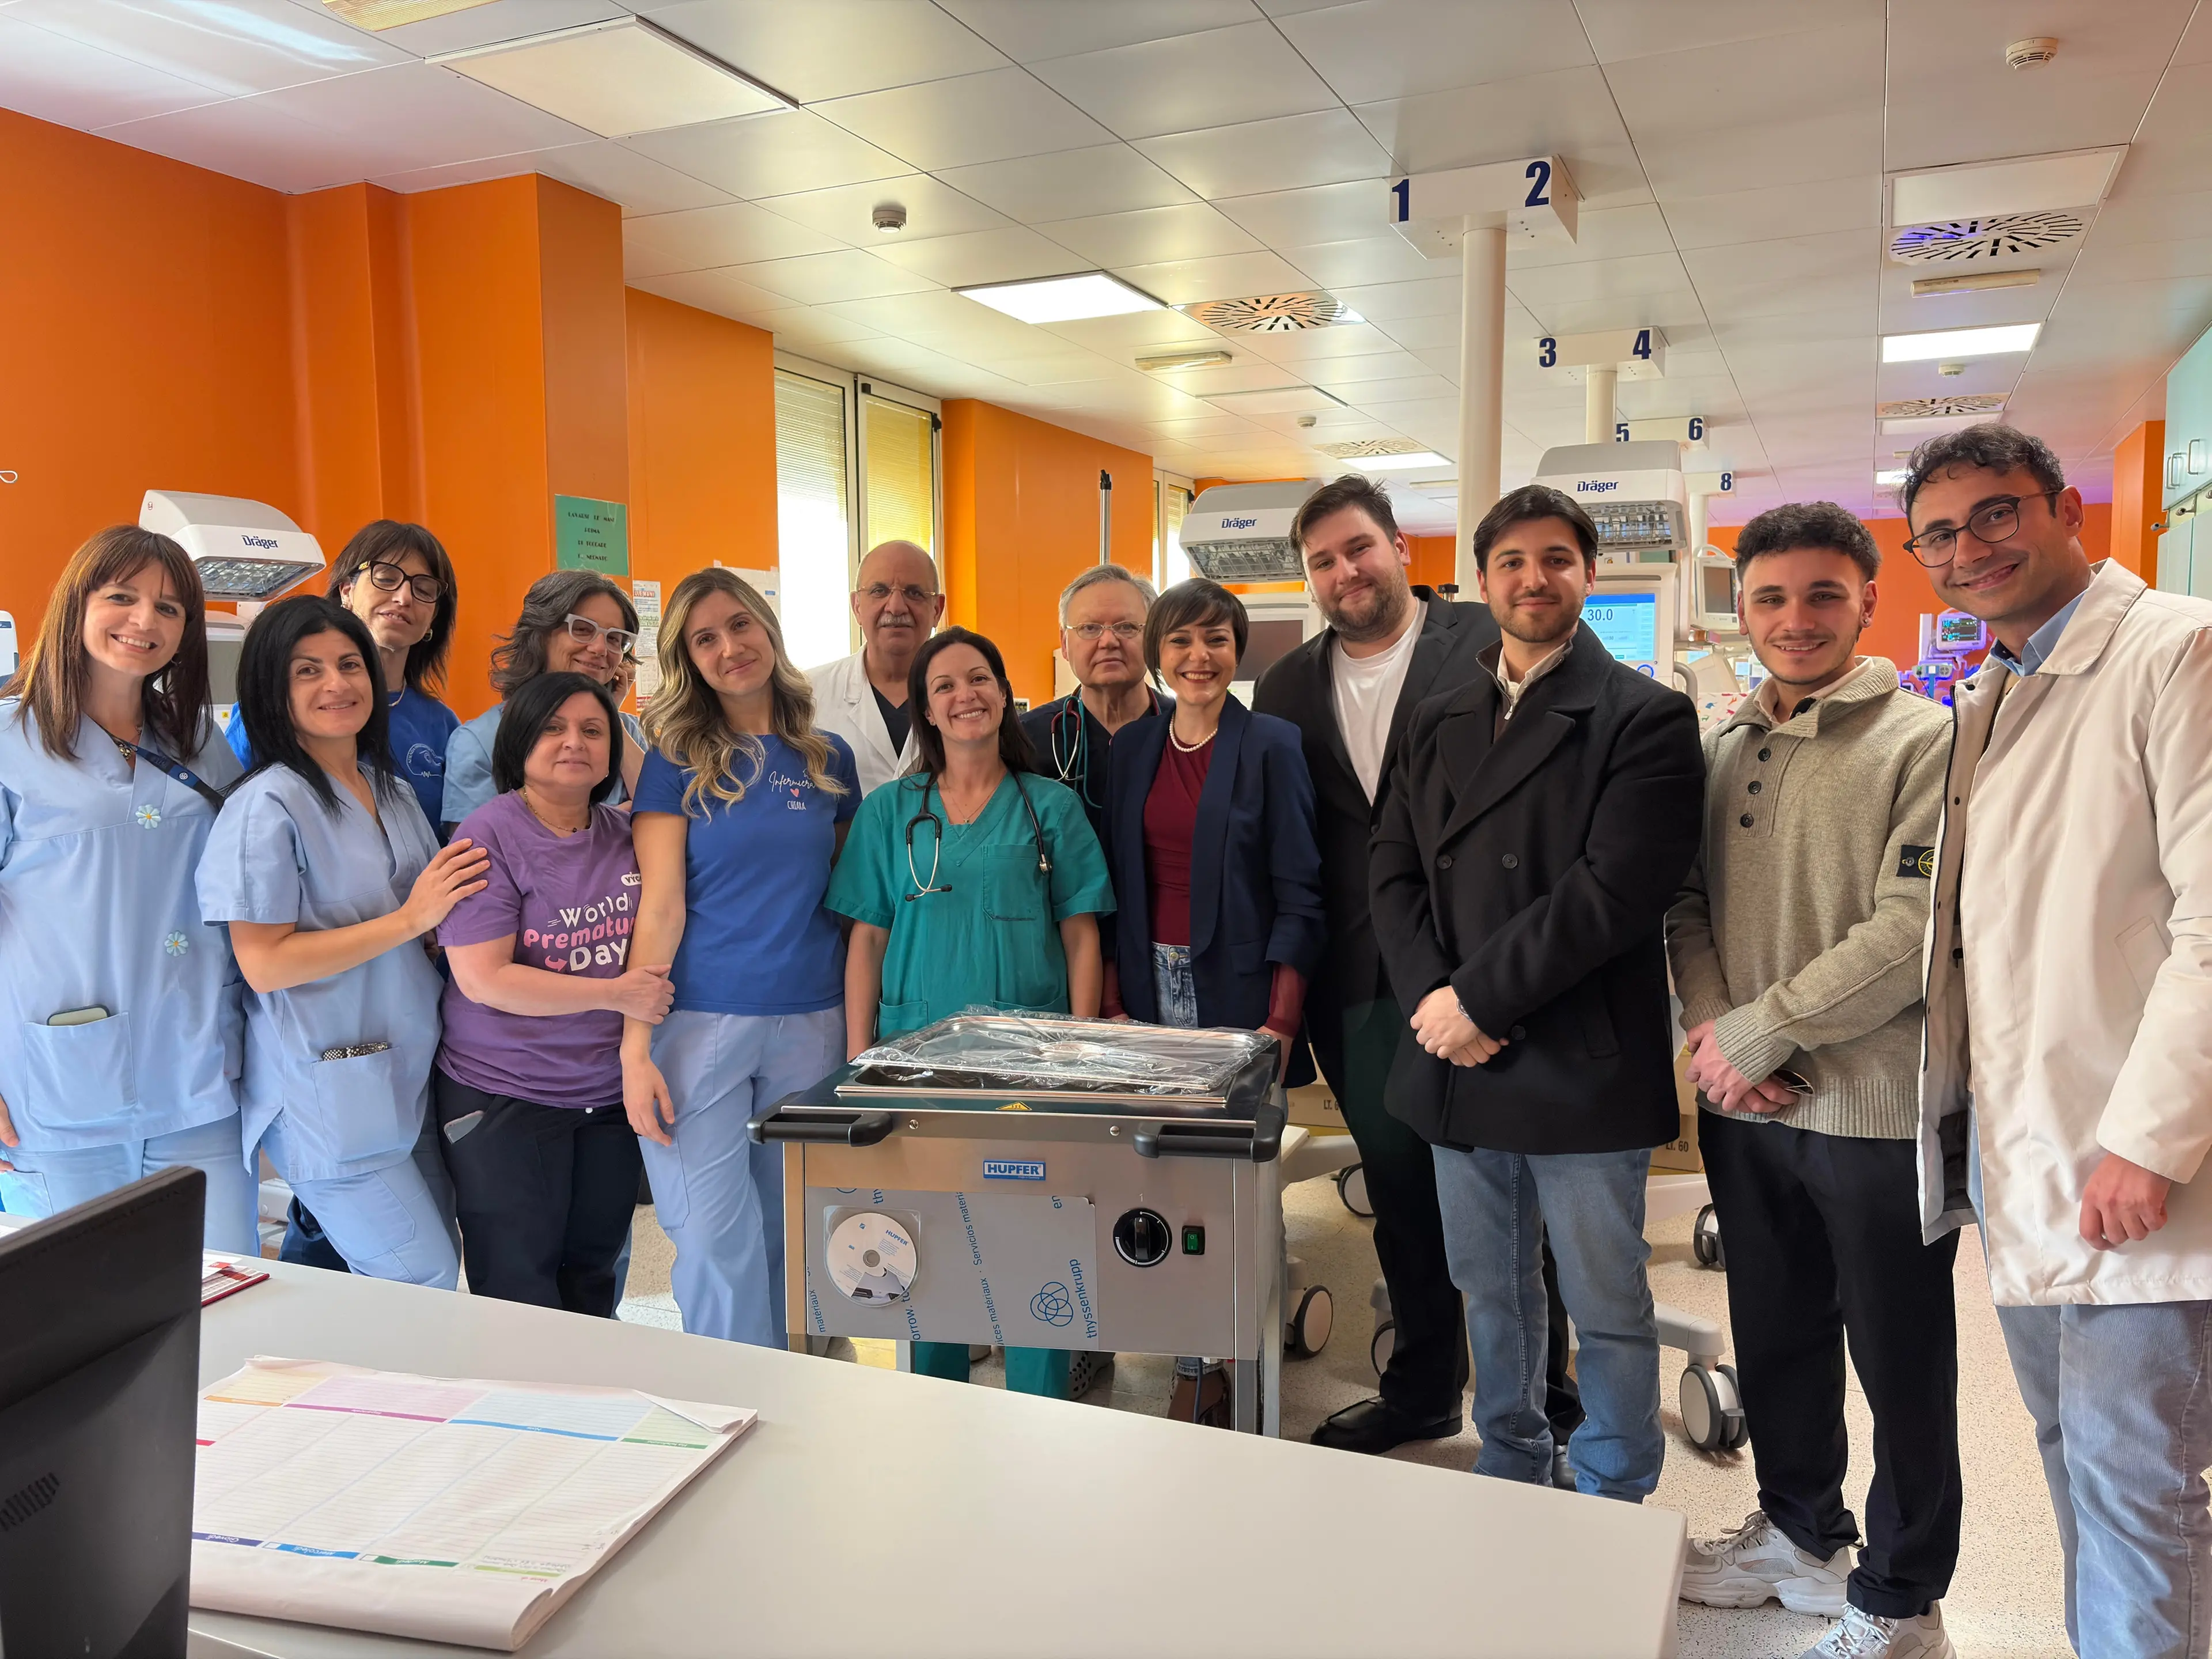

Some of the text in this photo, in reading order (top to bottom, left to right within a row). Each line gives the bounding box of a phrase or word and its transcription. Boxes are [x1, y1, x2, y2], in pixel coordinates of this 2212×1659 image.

[1392, 161, 1551, 222] 1 2
[1539, 329, 1652, 368] 3 4
[1616, 418, 1703, 442] 5 6
[1577, 480, 1619, 493] Dräger
[1720, 473, 1732, 491] 8
[1222, 517, 1257, 529] Dräger
[241, 535, 278, 549] Dräger
[1587, 609, 1613, 621] 30.0
[768, 771, 816, 793] Infermiera
[787, 800, 806, 810] CHIARA
[559, 892, 628, 929] World
[1323, 1100, 1332, 1110] LT.
[1679, 1141, 1689, 1152] 60
[987, 1164, 1040, 1175] HUPFER
[885, 1229, 908, 1246] HUPFER
[966, 1225, 982, 1266] Servicios
[981, 1277, 998, 1321] matériaux
[1069, 1258, 1097, 1339] thyssenkrupp
[809, 1289, 825, 1332] matériaux
